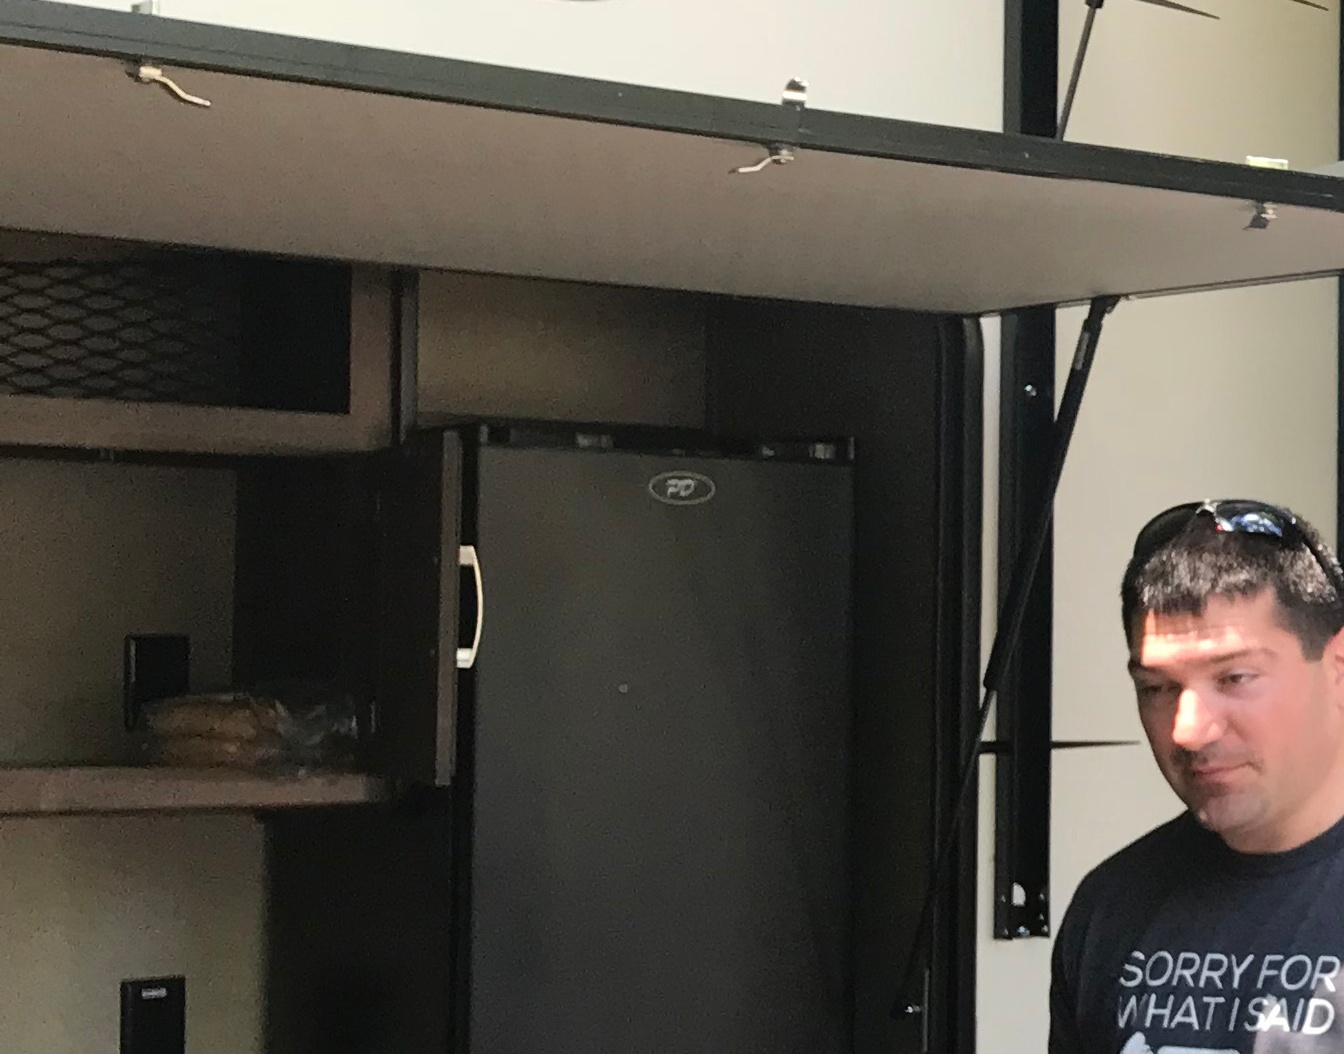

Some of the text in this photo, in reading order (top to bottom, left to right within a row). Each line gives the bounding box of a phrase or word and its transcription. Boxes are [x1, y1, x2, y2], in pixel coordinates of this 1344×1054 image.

[1119, 951, 1341, 992] SORRY FOR
[1118, 993, 1335, 1035] WHAT I SAID
